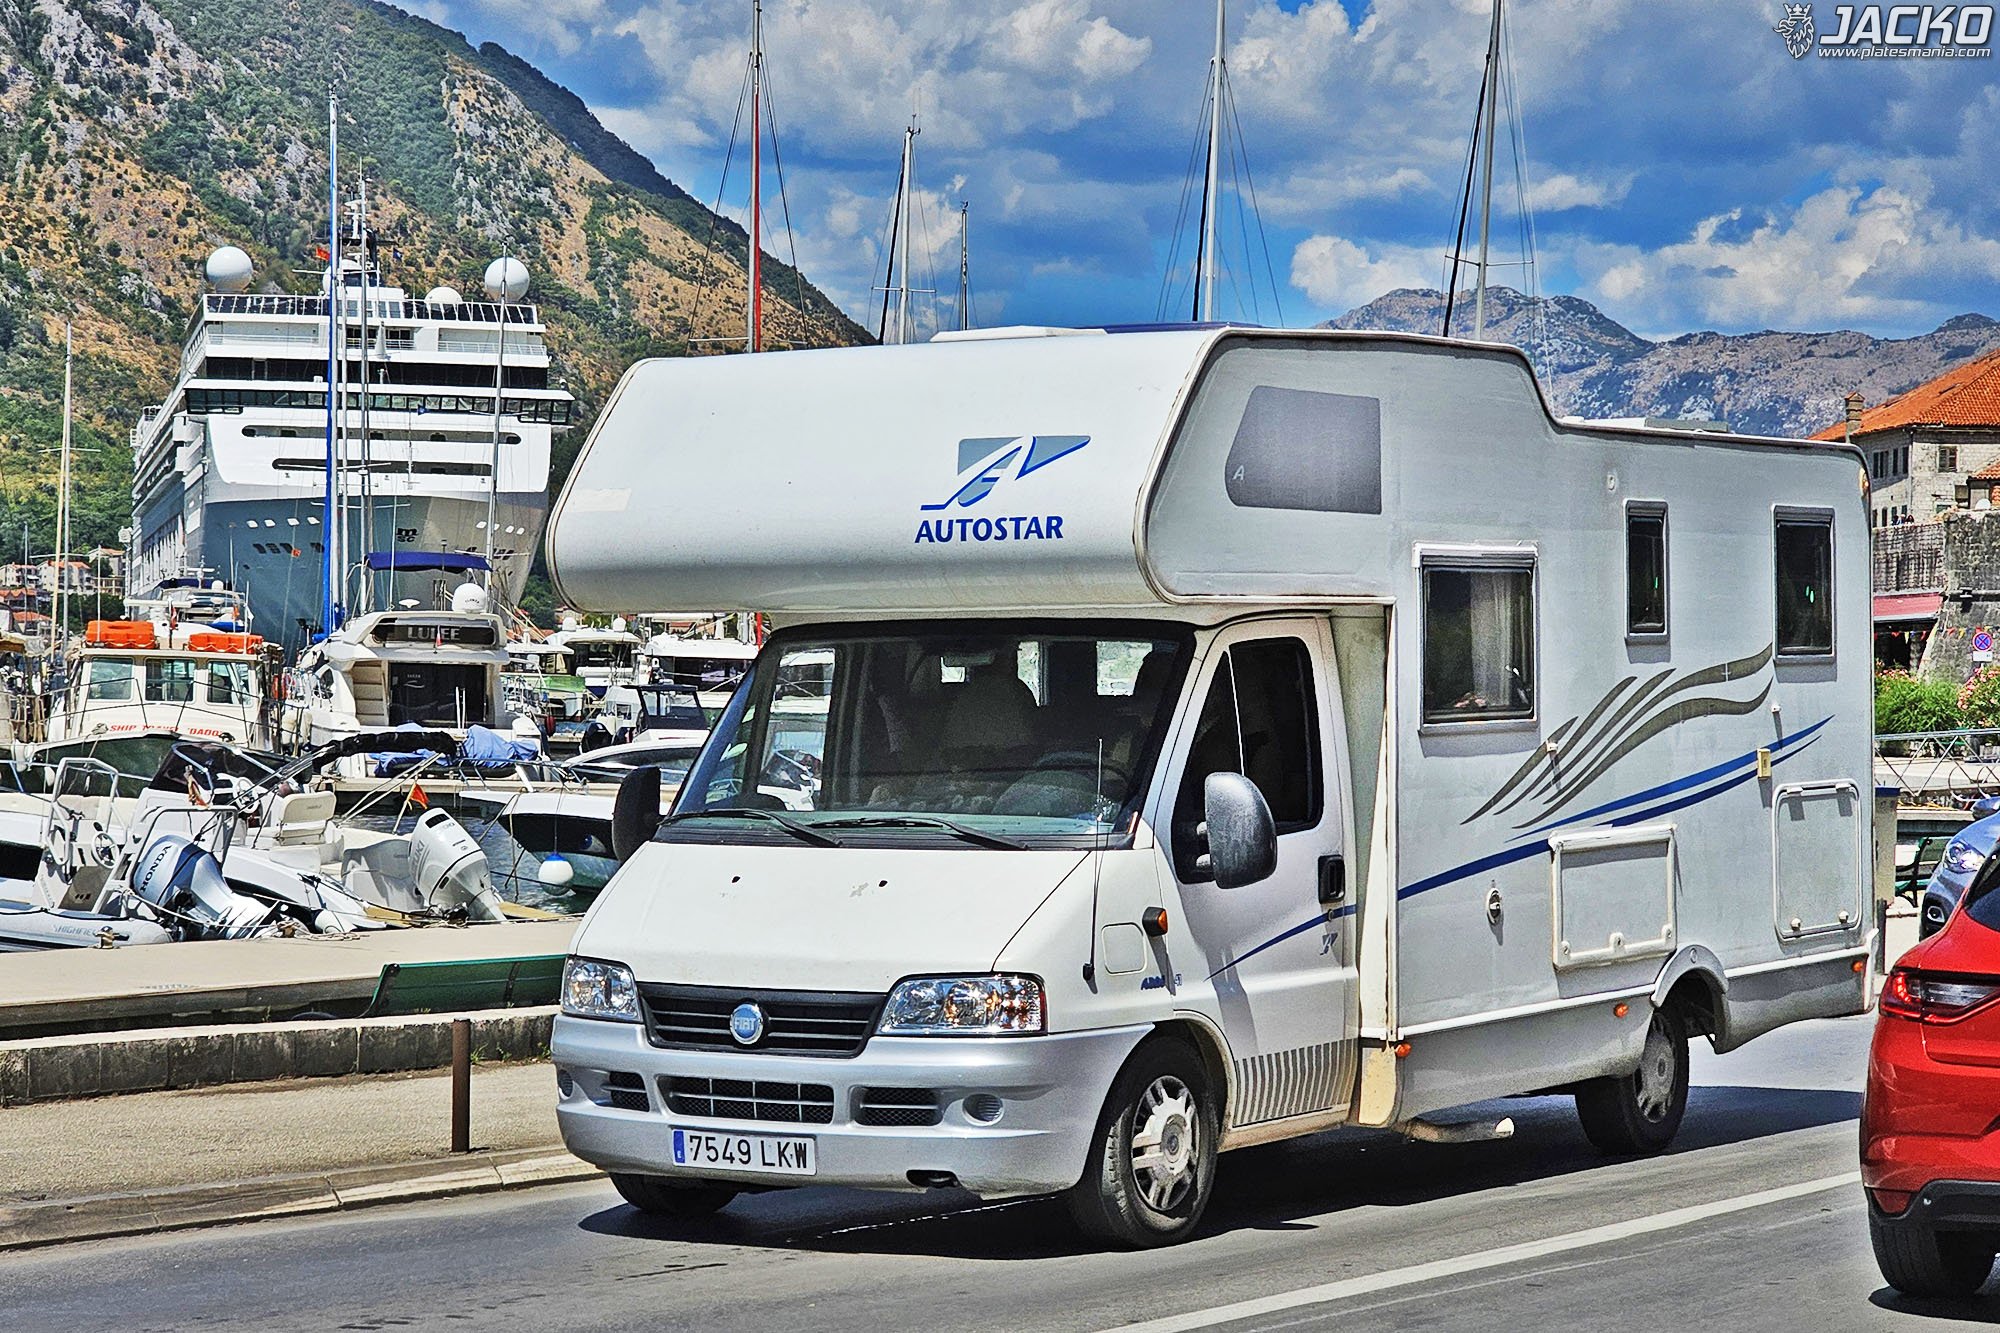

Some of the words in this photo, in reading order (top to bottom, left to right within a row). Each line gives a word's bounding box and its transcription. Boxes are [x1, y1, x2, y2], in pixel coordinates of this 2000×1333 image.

[914, 515, 1064, 544] AUTOSTAR
[109, 724, 137, 732] SHIP
[140, 845, 173, 893] HONDA
[734, 1017, 757, 1031] FIAT
[676, 1150, 683, 1159] E
[689, 1135, 751, 1165] 7549
[760, 1140, 807, 1169] LKW
